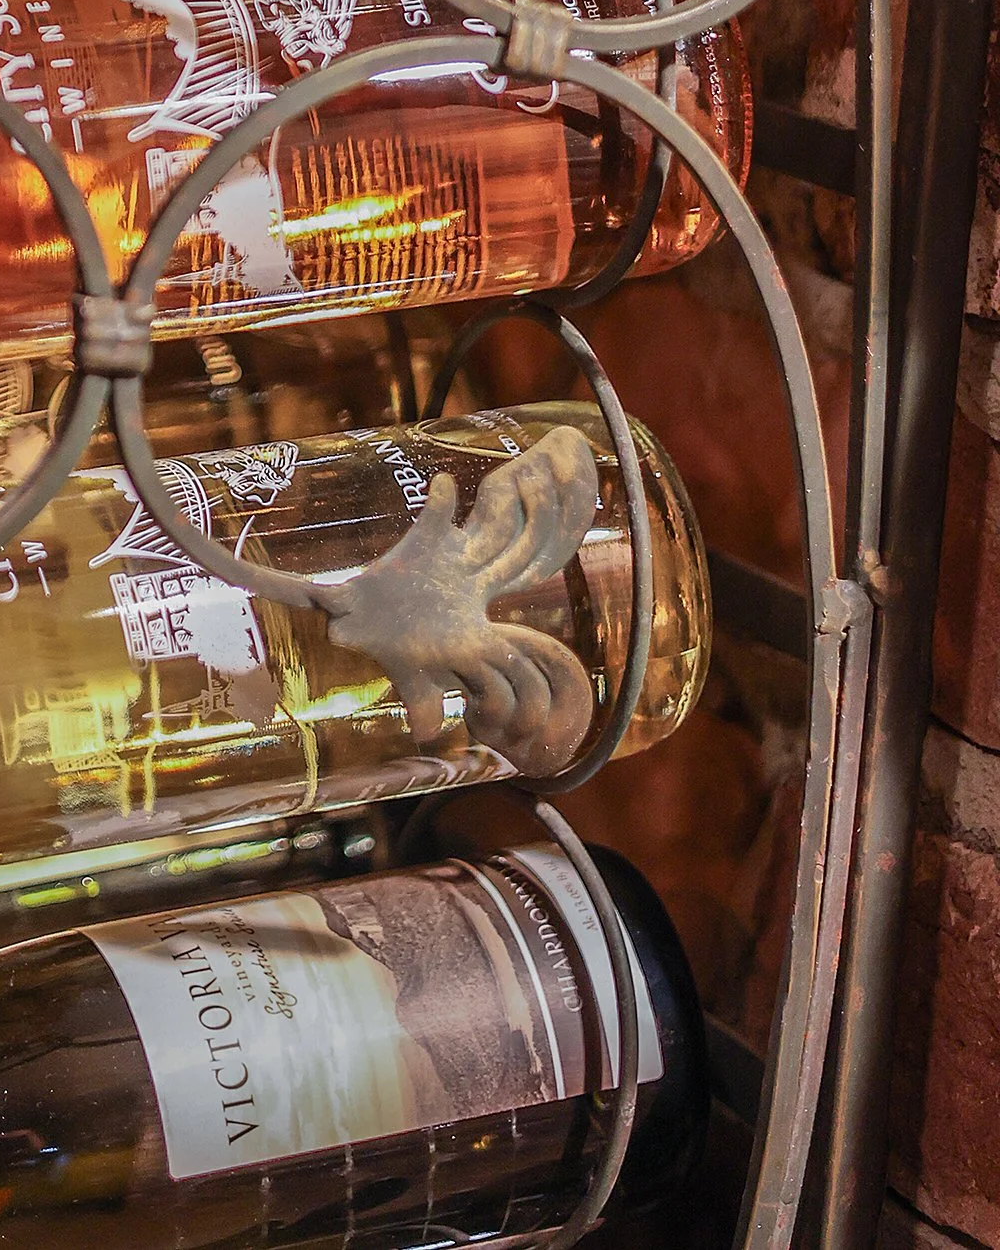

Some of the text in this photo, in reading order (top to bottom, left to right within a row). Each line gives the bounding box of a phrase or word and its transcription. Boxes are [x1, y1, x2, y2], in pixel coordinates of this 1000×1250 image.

[204, 920, 256, 1002] vineyards
[247, 939, 298, 1019] Signature
[172, 945, 260, 1146] VICTORIA
